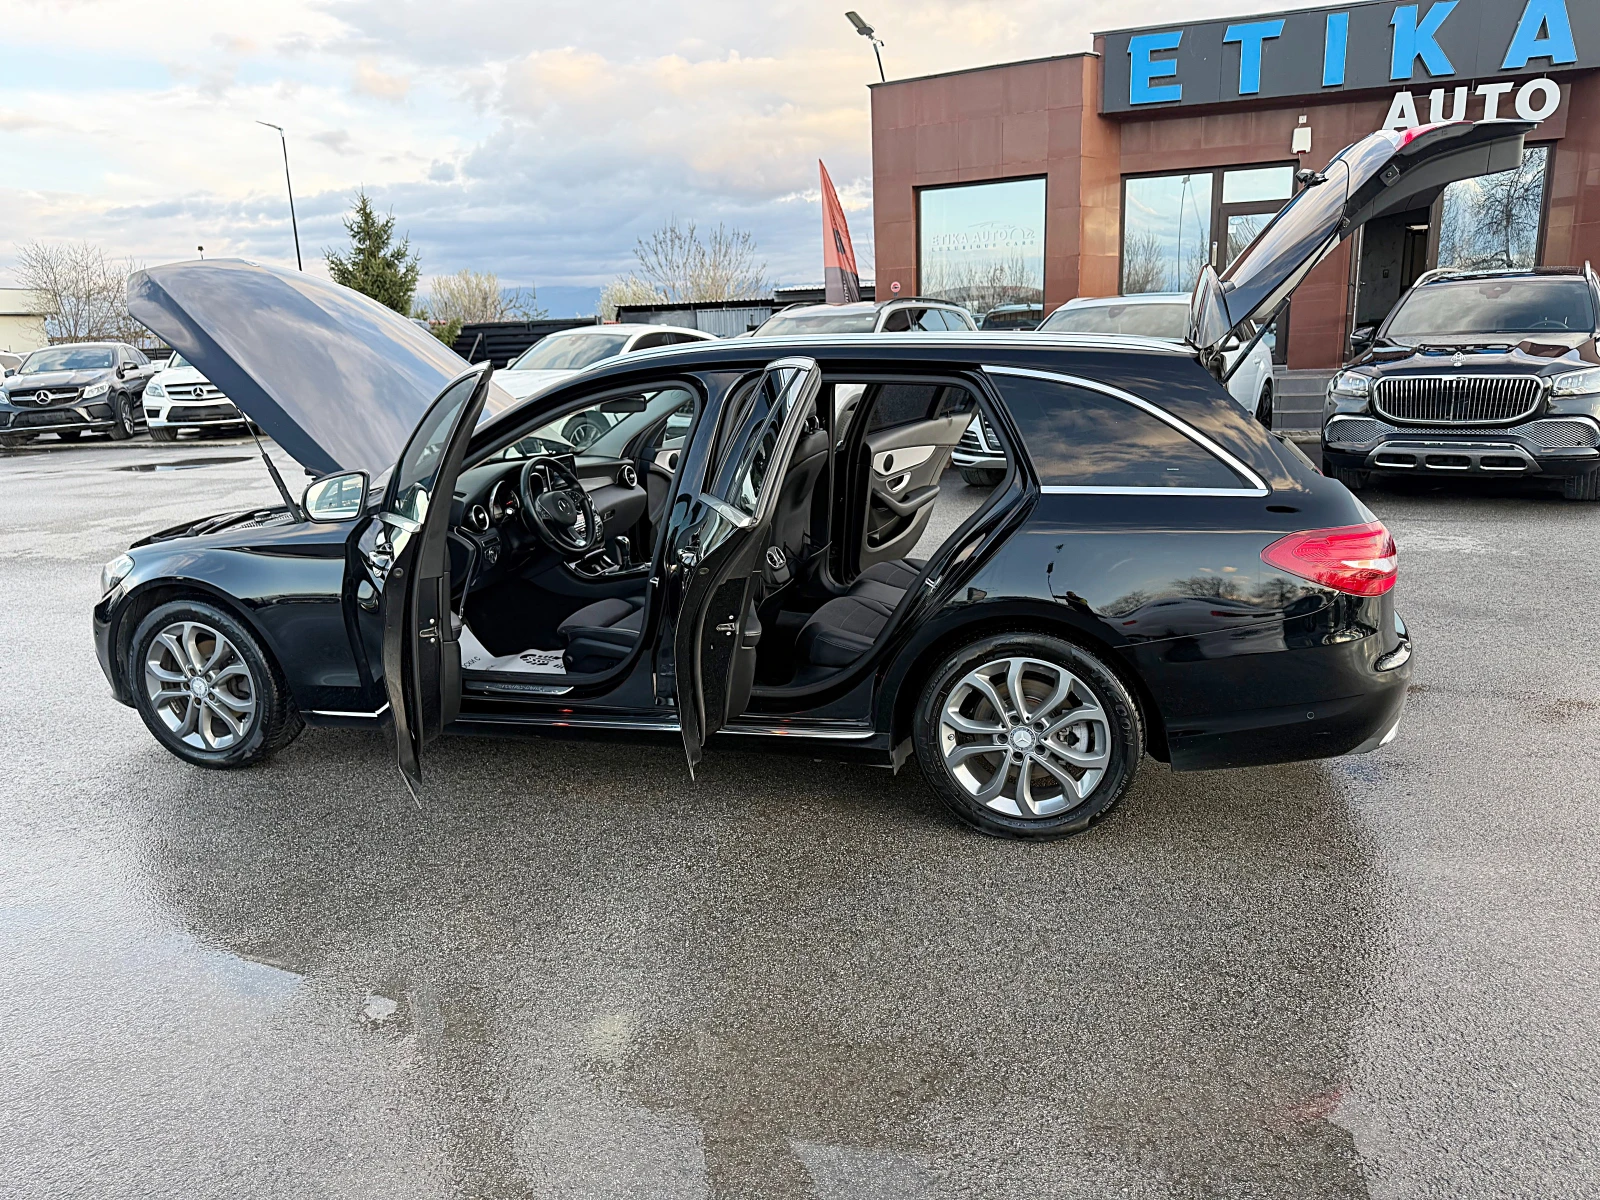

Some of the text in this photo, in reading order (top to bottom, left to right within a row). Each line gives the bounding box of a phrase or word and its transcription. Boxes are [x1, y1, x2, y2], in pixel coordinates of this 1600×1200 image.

[1127, 0, 1577, 105] ETIKA
[1382, 78, 1561, 130] AUTO
[932, 232, 969, 247] ETIKA
